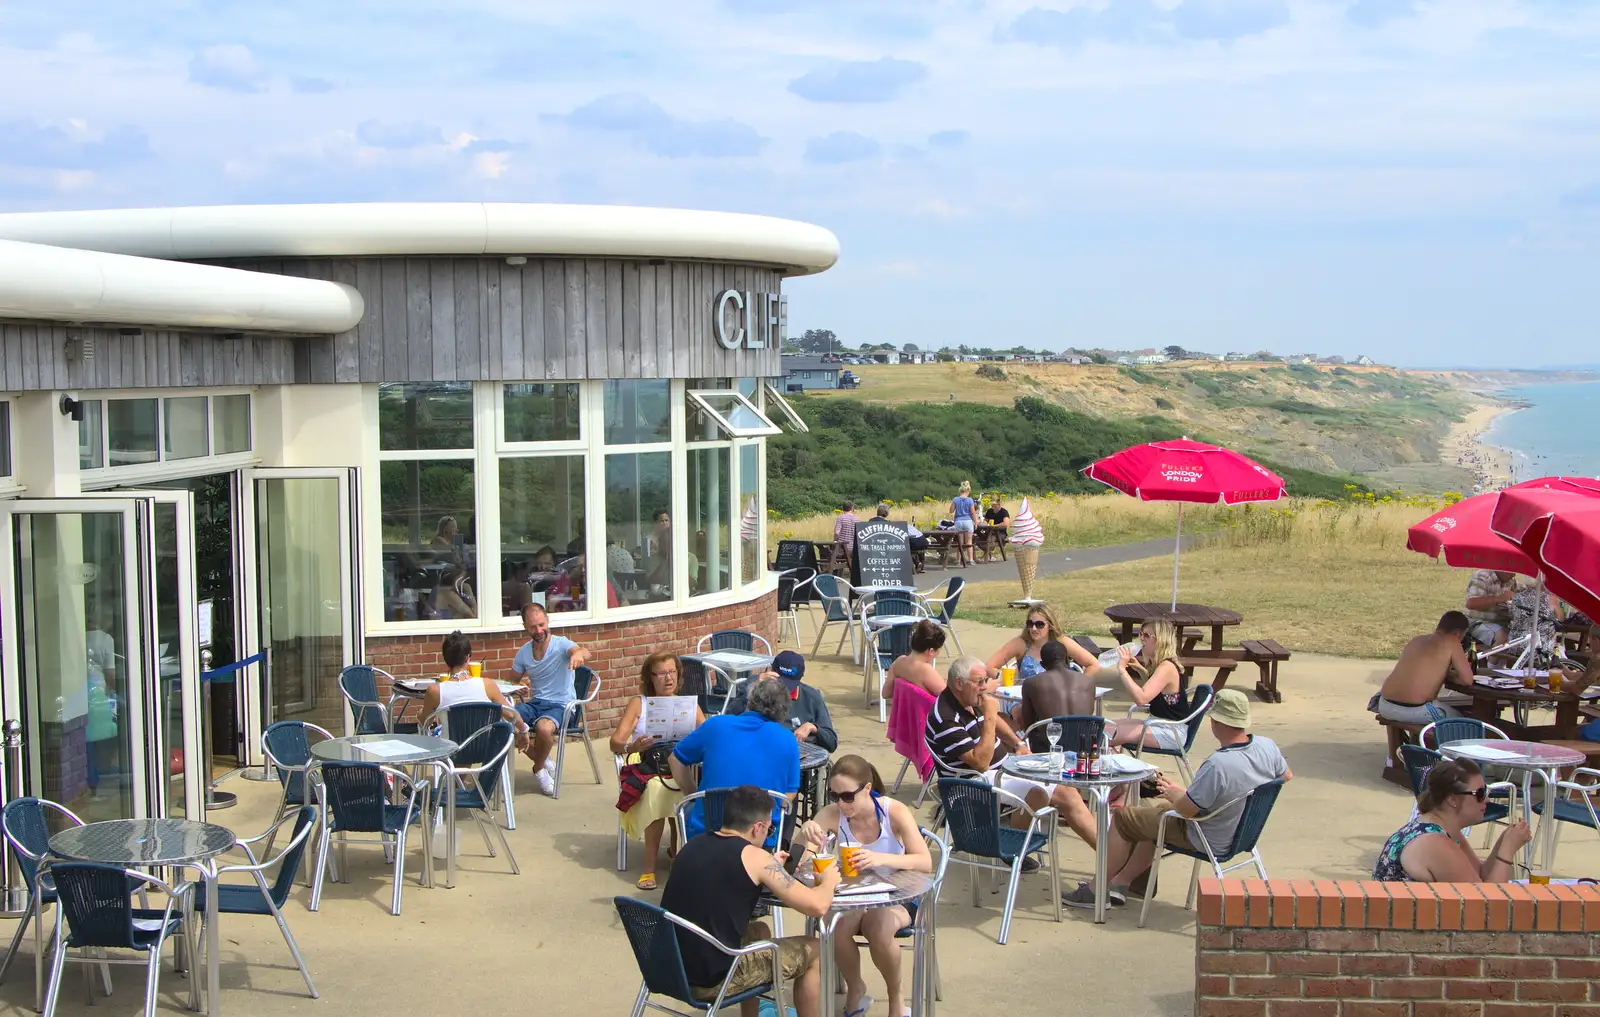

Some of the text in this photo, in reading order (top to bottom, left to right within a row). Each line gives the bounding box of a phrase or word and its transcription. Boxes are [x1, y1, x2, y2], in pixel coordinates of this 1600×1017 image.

[1161, 463, 1204, 471] FULLER'S
[1161, 469, 1203, 479] LONDON
[1166, 475, 1197, 483] PRIDE
[1233, 488, 1270, 501] FULLER'S
[857, 524, 909, 541] CLIFFHANGER
[871, 544, 886, 552] TABLE
[887, 544, 907, 552] NUMBER
[871, 579, 903, 587] ORDER
